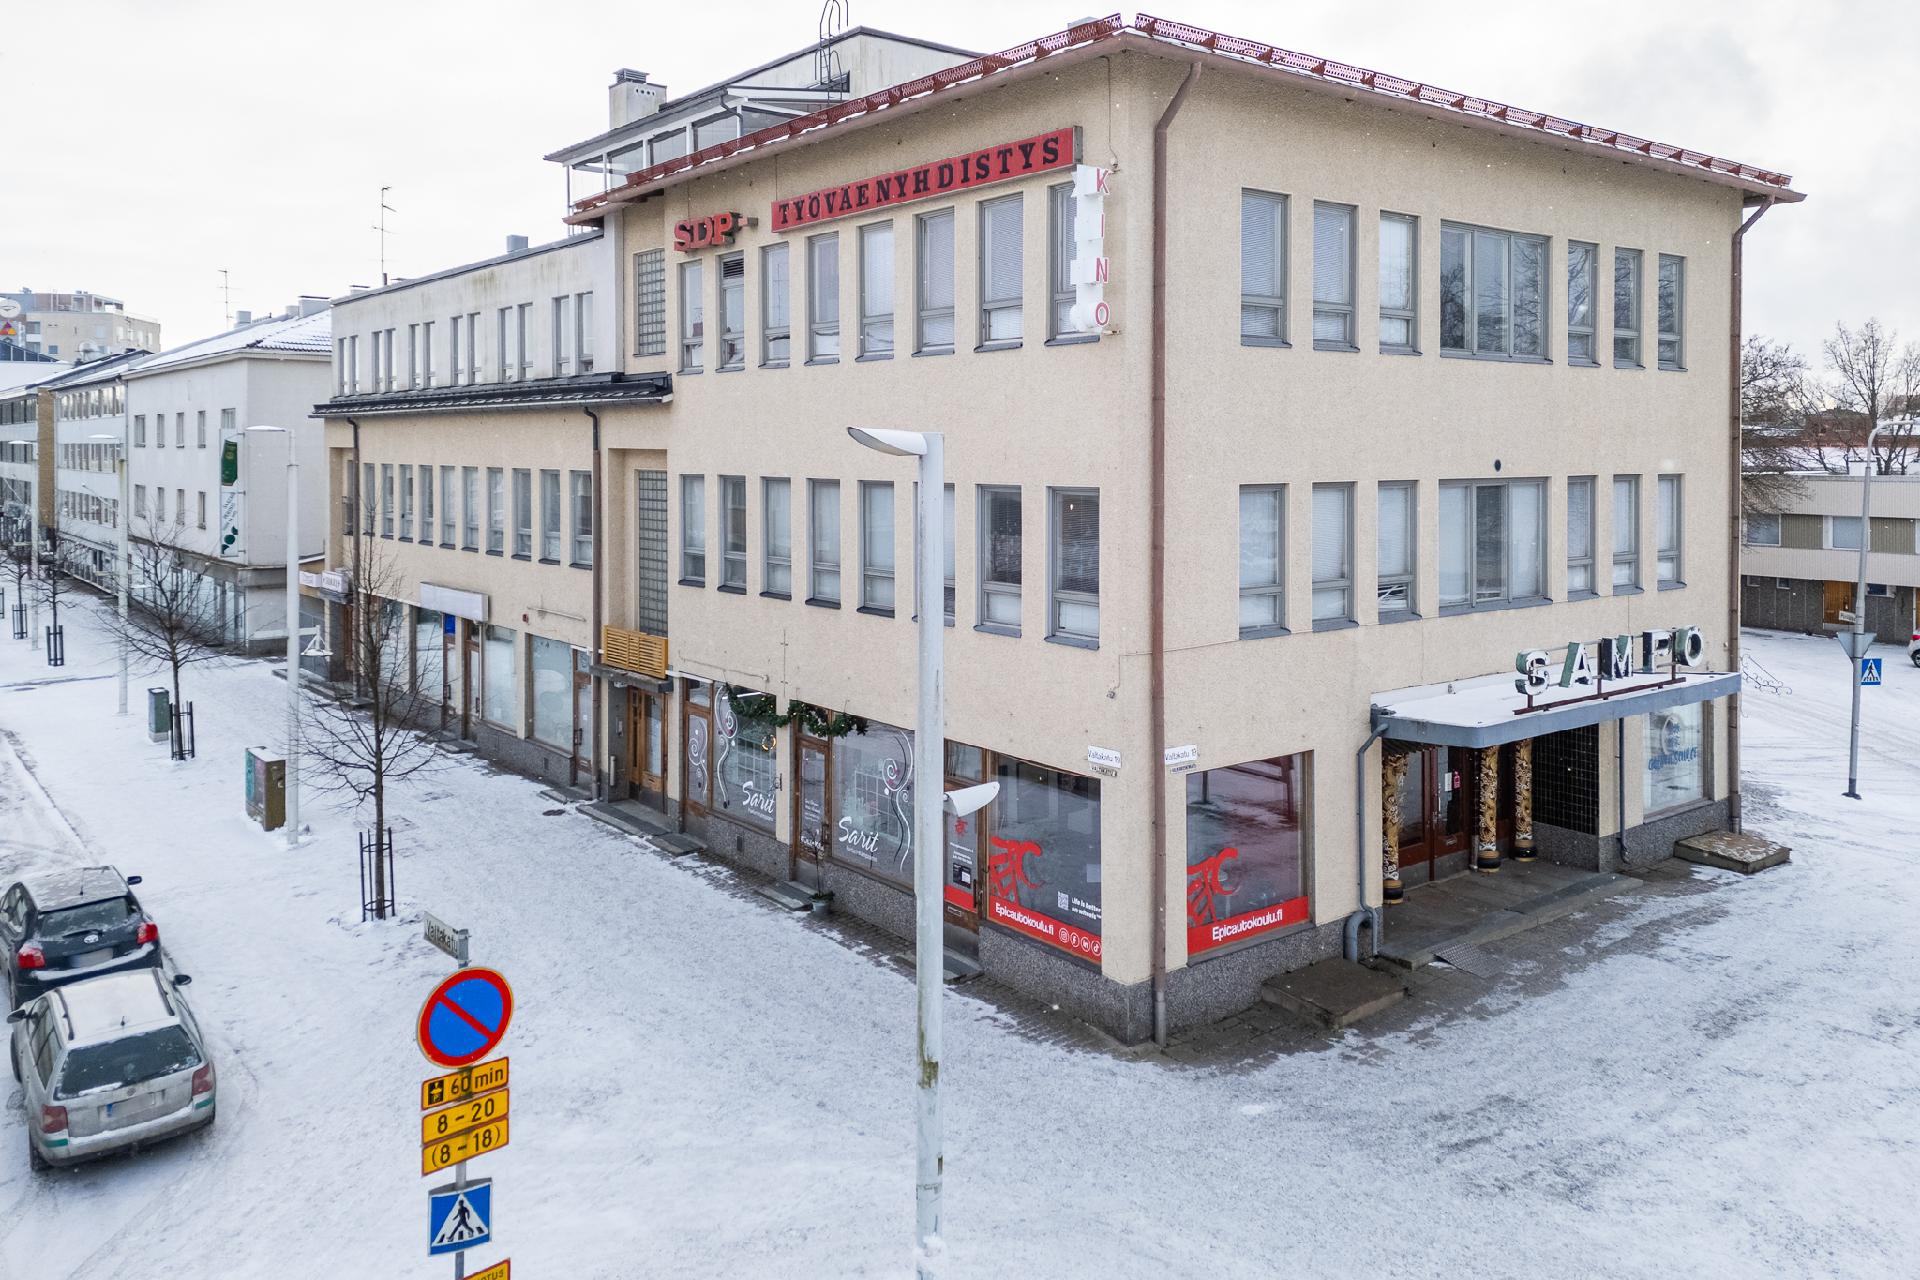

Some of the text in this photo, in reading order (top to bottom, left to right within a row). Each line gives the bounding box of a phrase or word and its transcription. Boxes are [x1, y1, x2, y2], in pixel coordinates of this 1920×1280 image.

[779, 136, 1059, 224] TYÖVÄENYHDISTYS
[674, 212, 734, 252] SDP
[1096, 168, 1109, 325] KINO
[1515, 624, 1704, 696] SAMPO
[743, 781, 775, 814] Sarit
[839, 816, 879, 853] Sarit
[426, 919, 458, 953] Valtakatu
[995, 902, 1054, 935] Epicautokoulu.fi
[1212, 908, 1283, 942] Epicautokoulu.fi
[451, 1068, 504, 1094] 60 min
[437, 1114, 448, 1133] 8
[472, 1098, 494, 1122] 20
